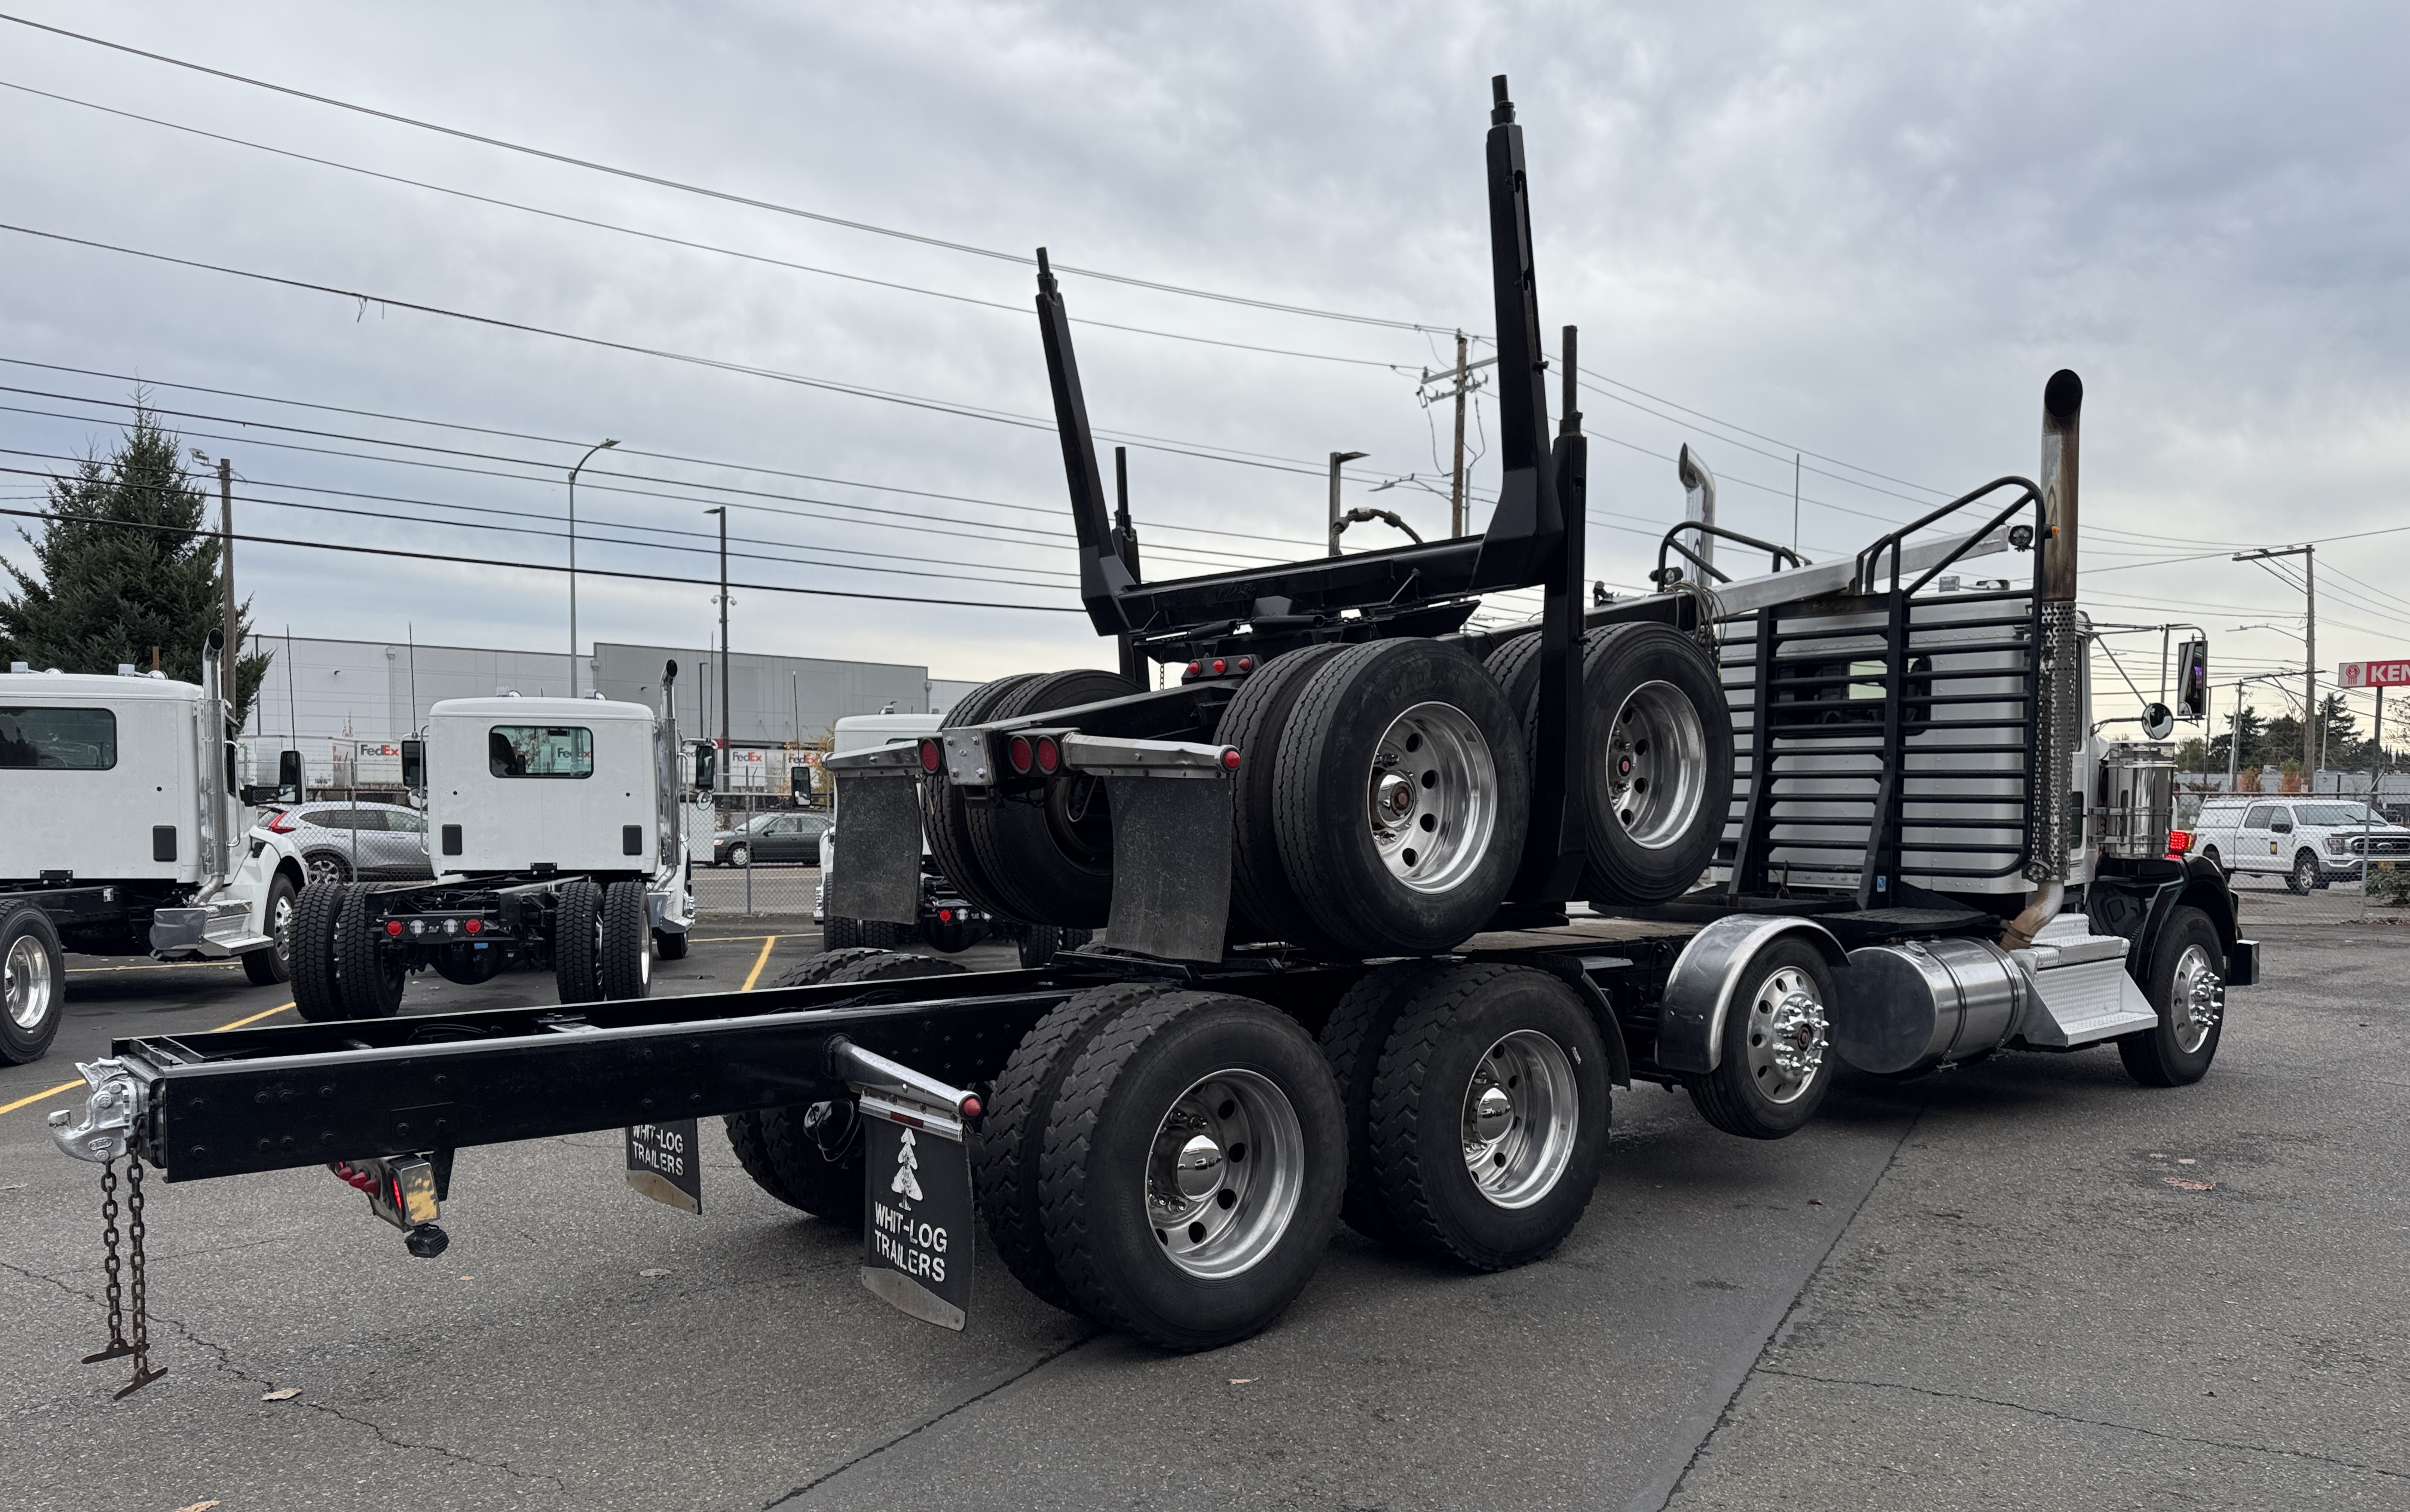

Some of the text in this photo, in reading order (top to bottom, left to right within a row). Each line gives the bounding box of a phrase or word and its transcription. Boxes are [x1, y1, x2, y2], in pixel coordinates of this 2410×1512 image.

[360, 745, 399, 756] FedEx
[557, 748, 591, 758] Fex
[732, 751, 762, 761] FedEx
[632, 1124, 684, 1154] WHIT-LOG
[632, 1141, 684, 1176] TRAILERS
[875, 1201, 947, 1253] WHIT-LOG
[874, 1229, 946, 1283] TRAILERS
